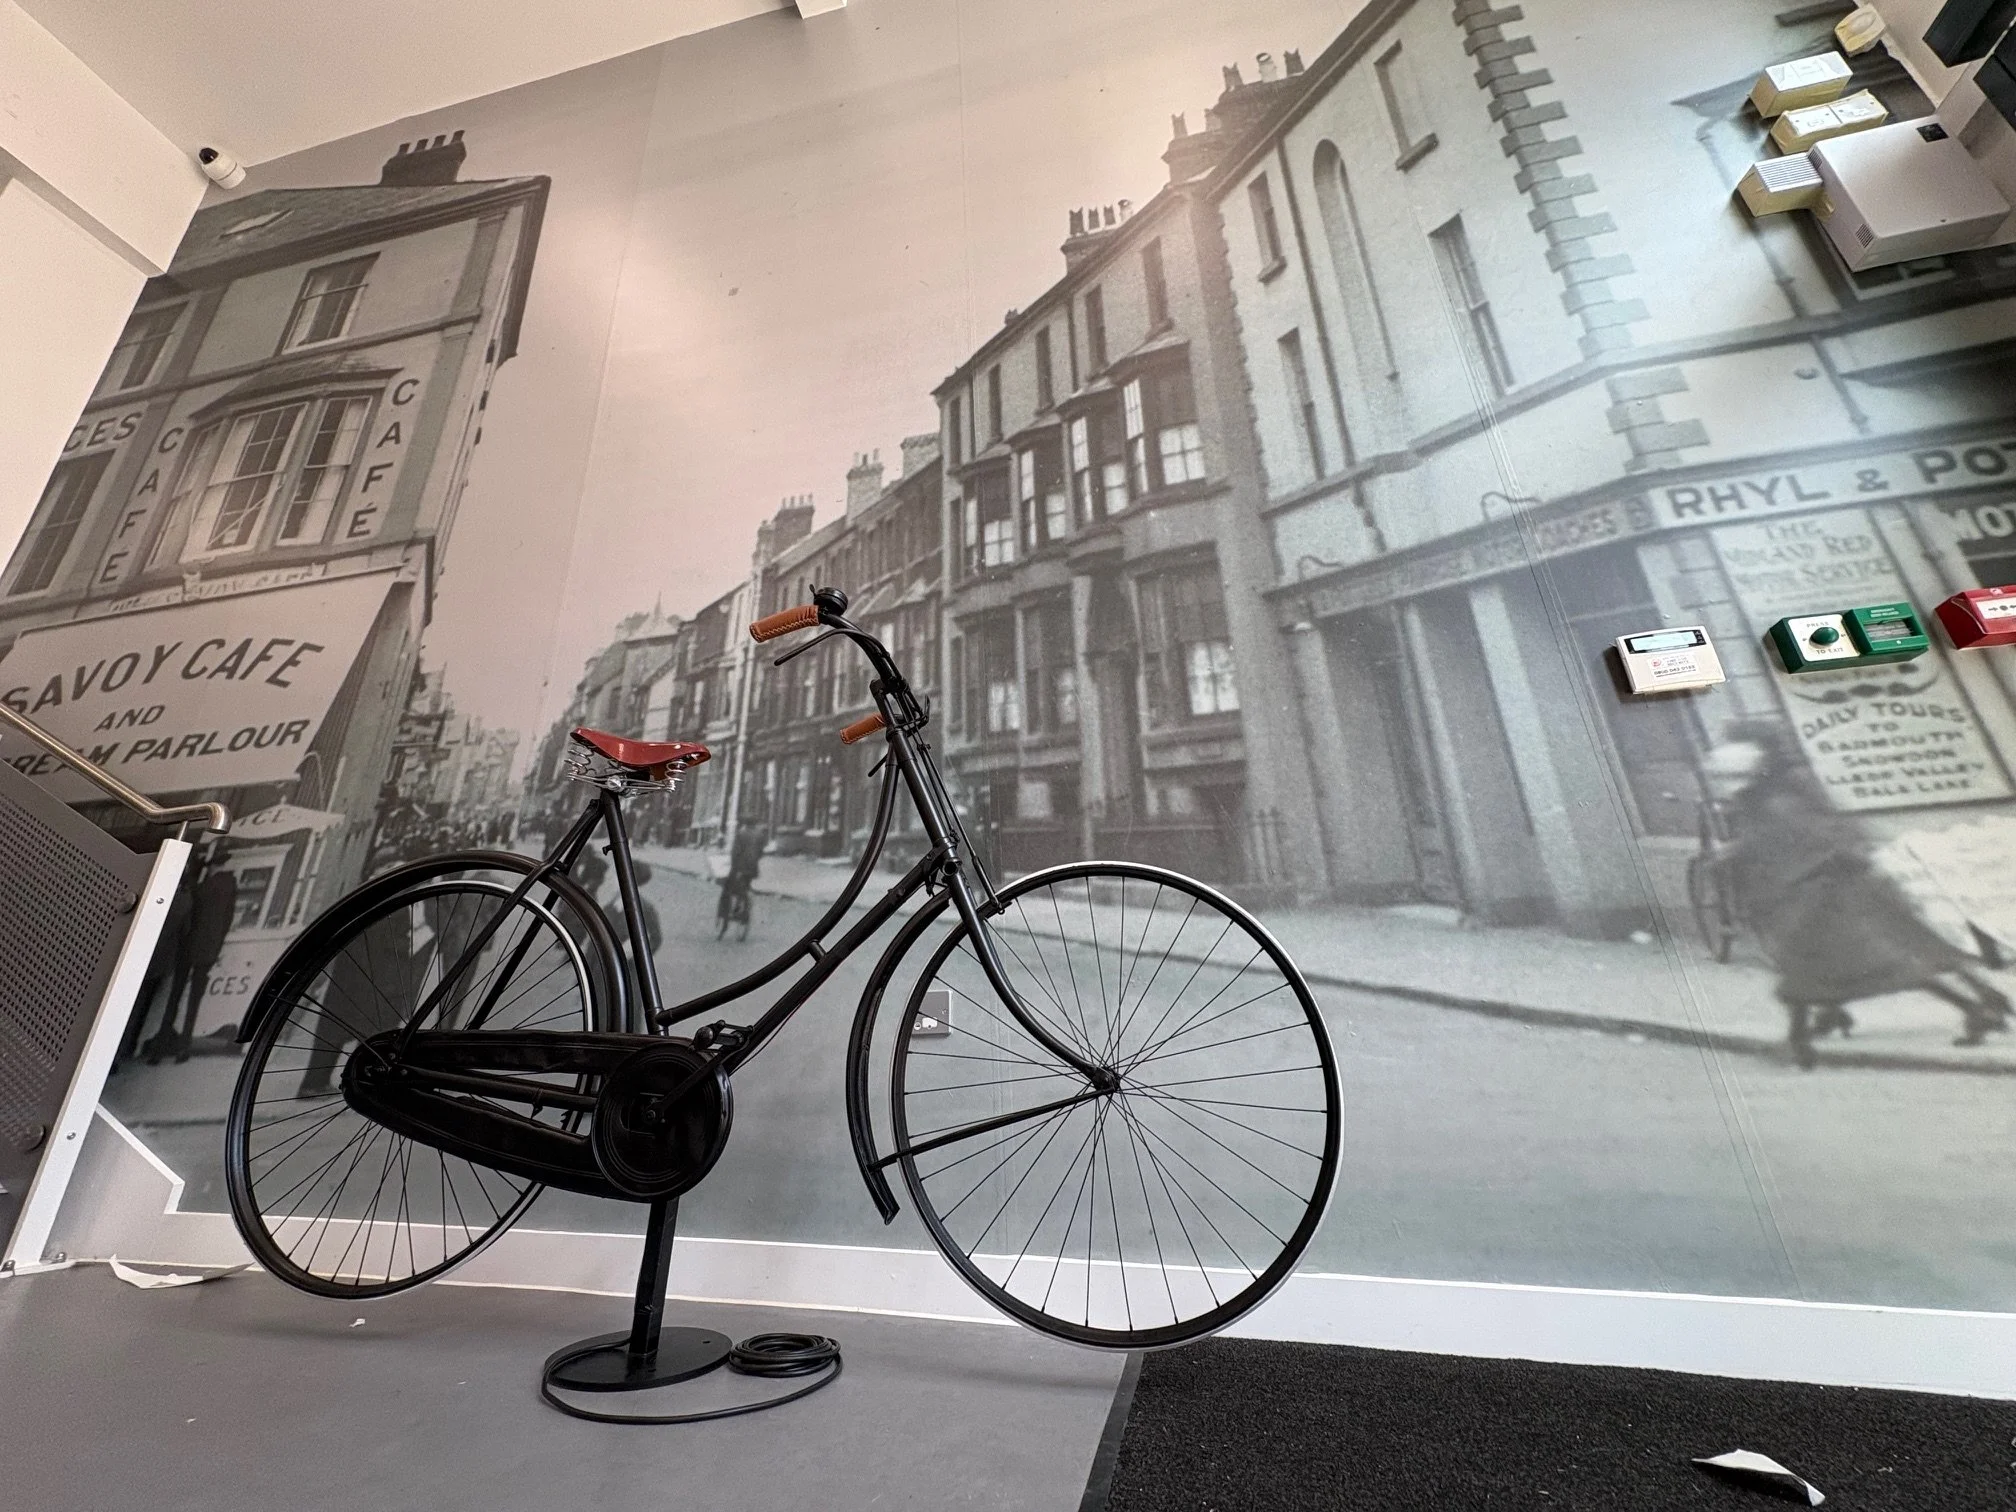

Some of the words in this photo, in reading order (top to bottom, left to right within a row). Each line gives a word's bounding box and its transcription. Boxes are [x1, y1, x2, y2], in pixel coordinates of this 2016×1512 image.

[1665, 474, 1831, 518] RHYL
[1855, 468, 1889, 492] &
[1912, 442, 2016, 485] PO
[2, 641, 183, 715] SAVOY
[181, 637, 326, 690] CAFE
[93, 704, 166, 732] AND
[121, 718, 311, 766] PARLOUR
[1801, 704, 1860, 740] DAILY
[1869, 701, 1966, 724] TOURS
